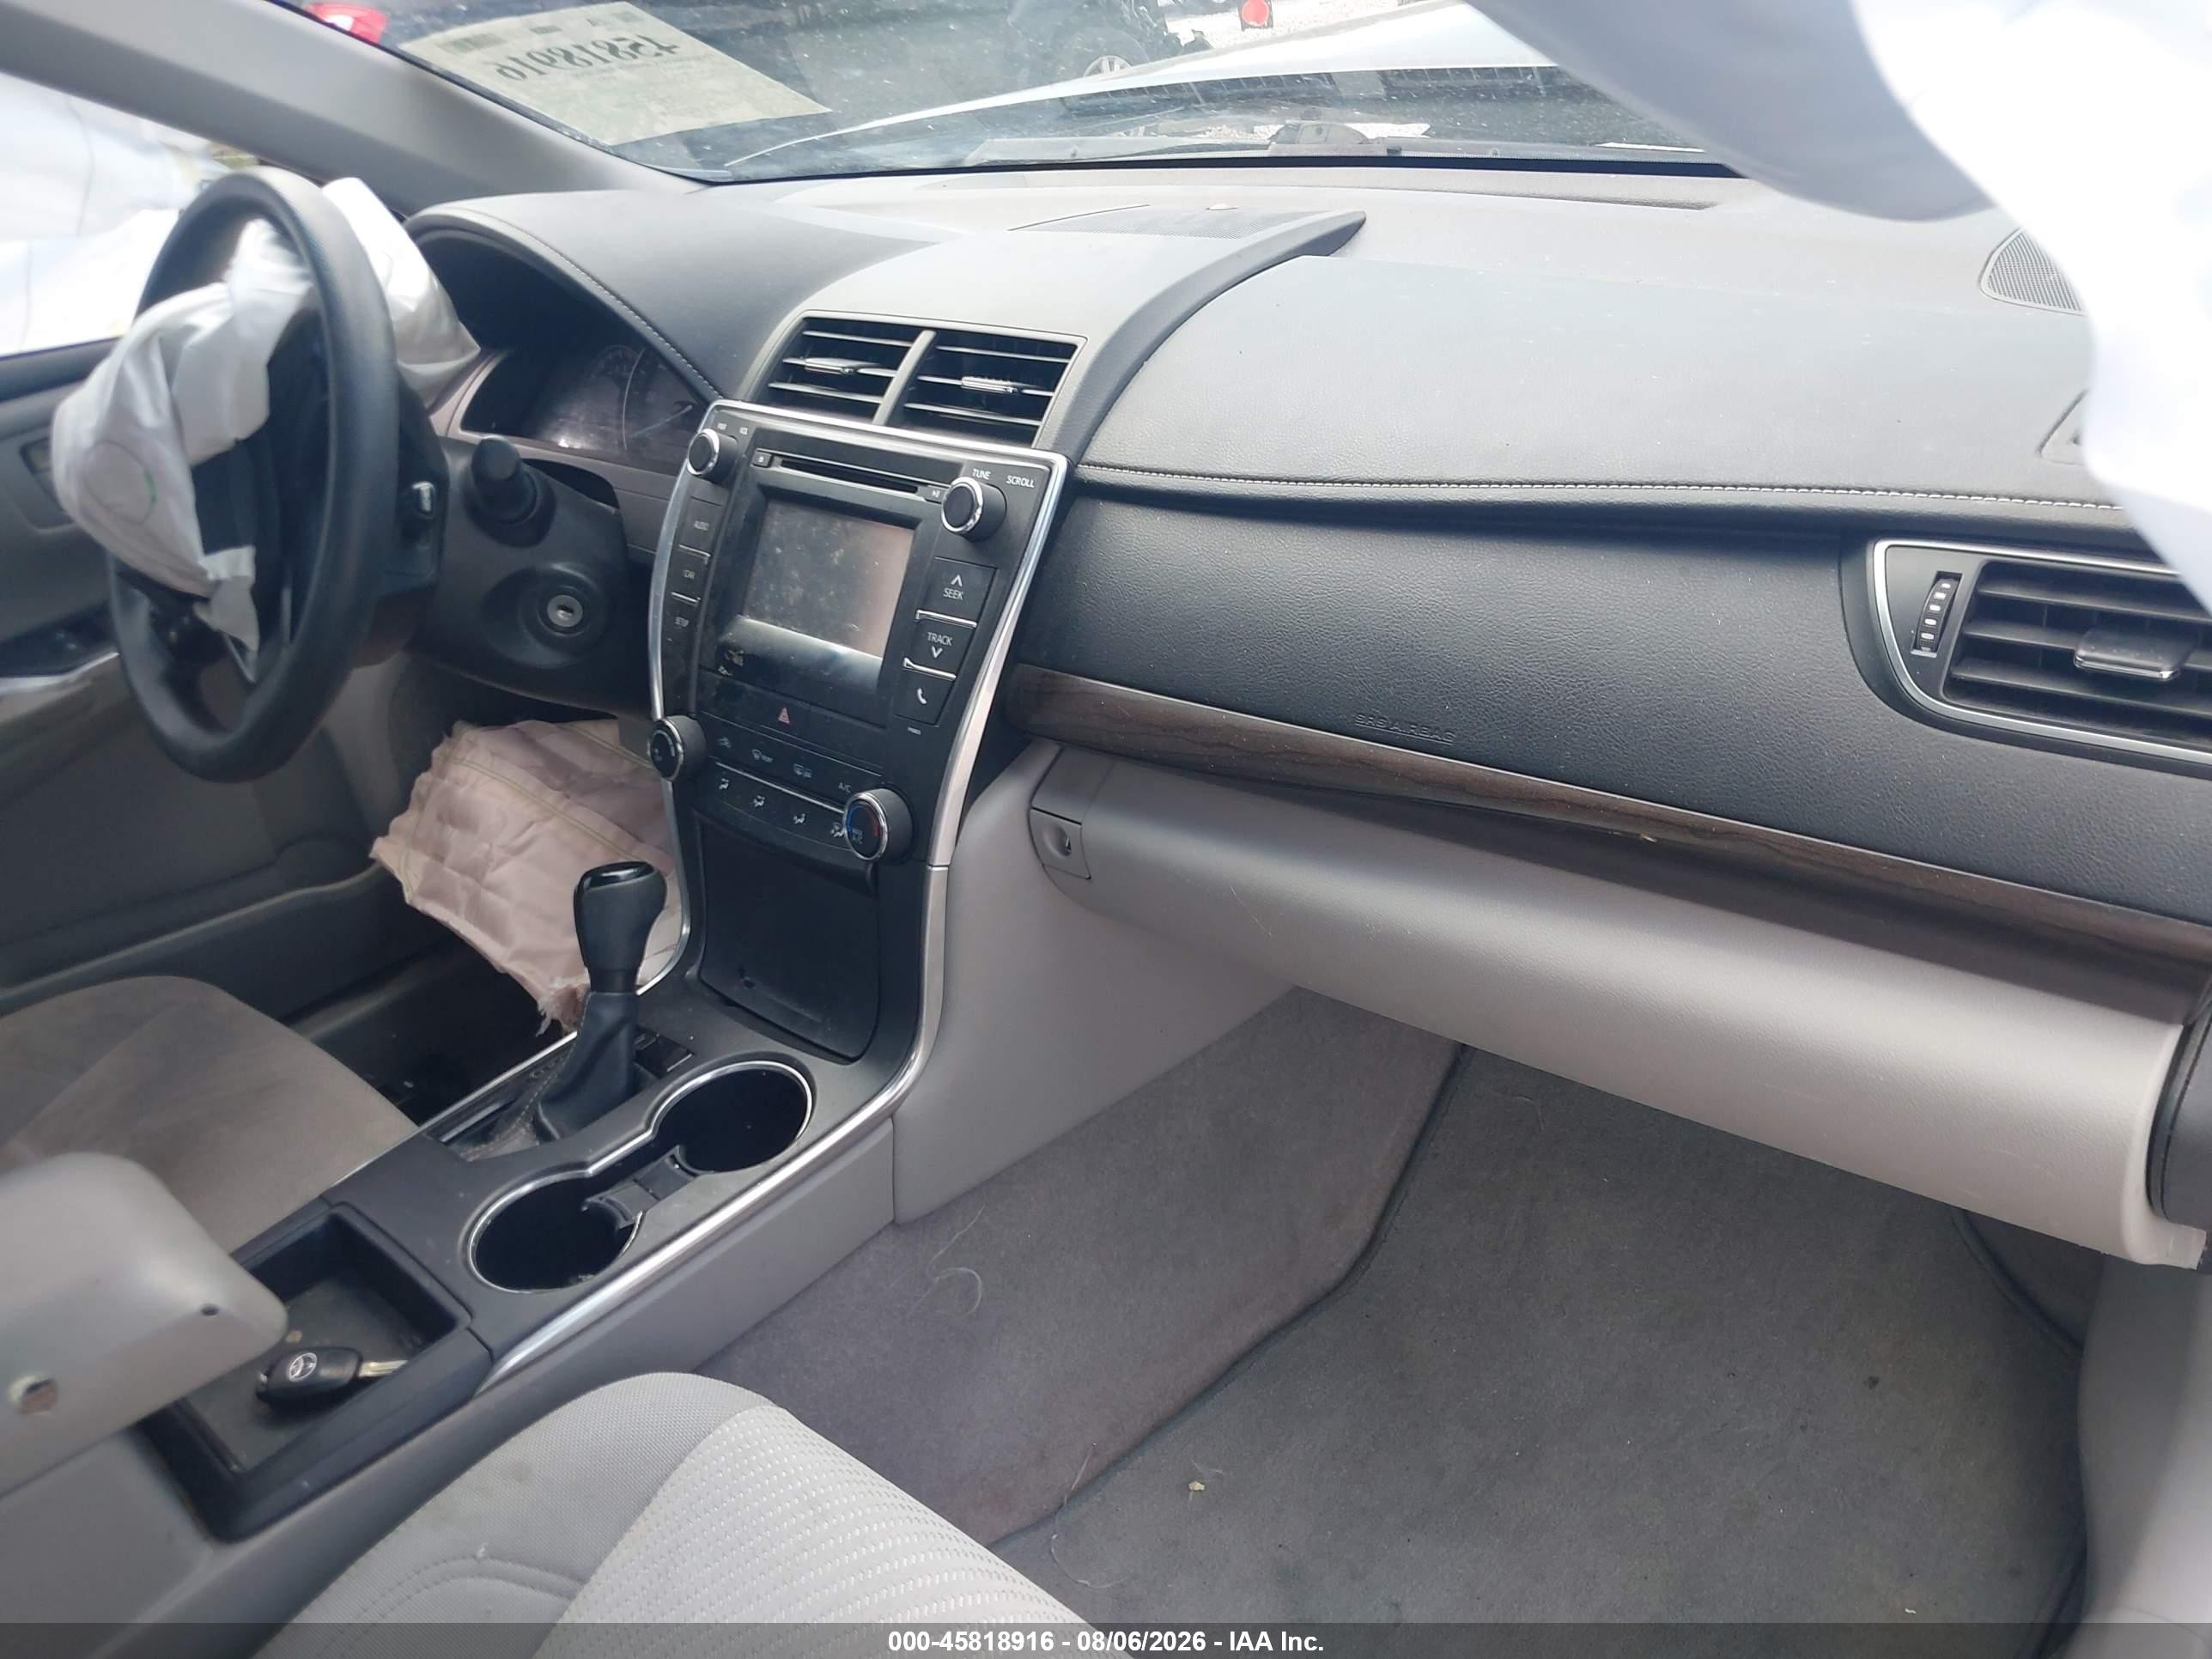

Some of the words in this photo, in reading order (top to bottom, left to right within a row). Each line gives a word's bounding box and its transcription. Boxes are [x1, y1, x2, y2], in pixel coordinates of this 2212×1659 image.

[972, 468, 992, 481] TUNE
[1006, 474, 1036, 489] SCROLL
[942, 587, 964, 601] SEEK
[927, 631, 953, 647] TRACK
[837, 781, 853, 794] A/C
